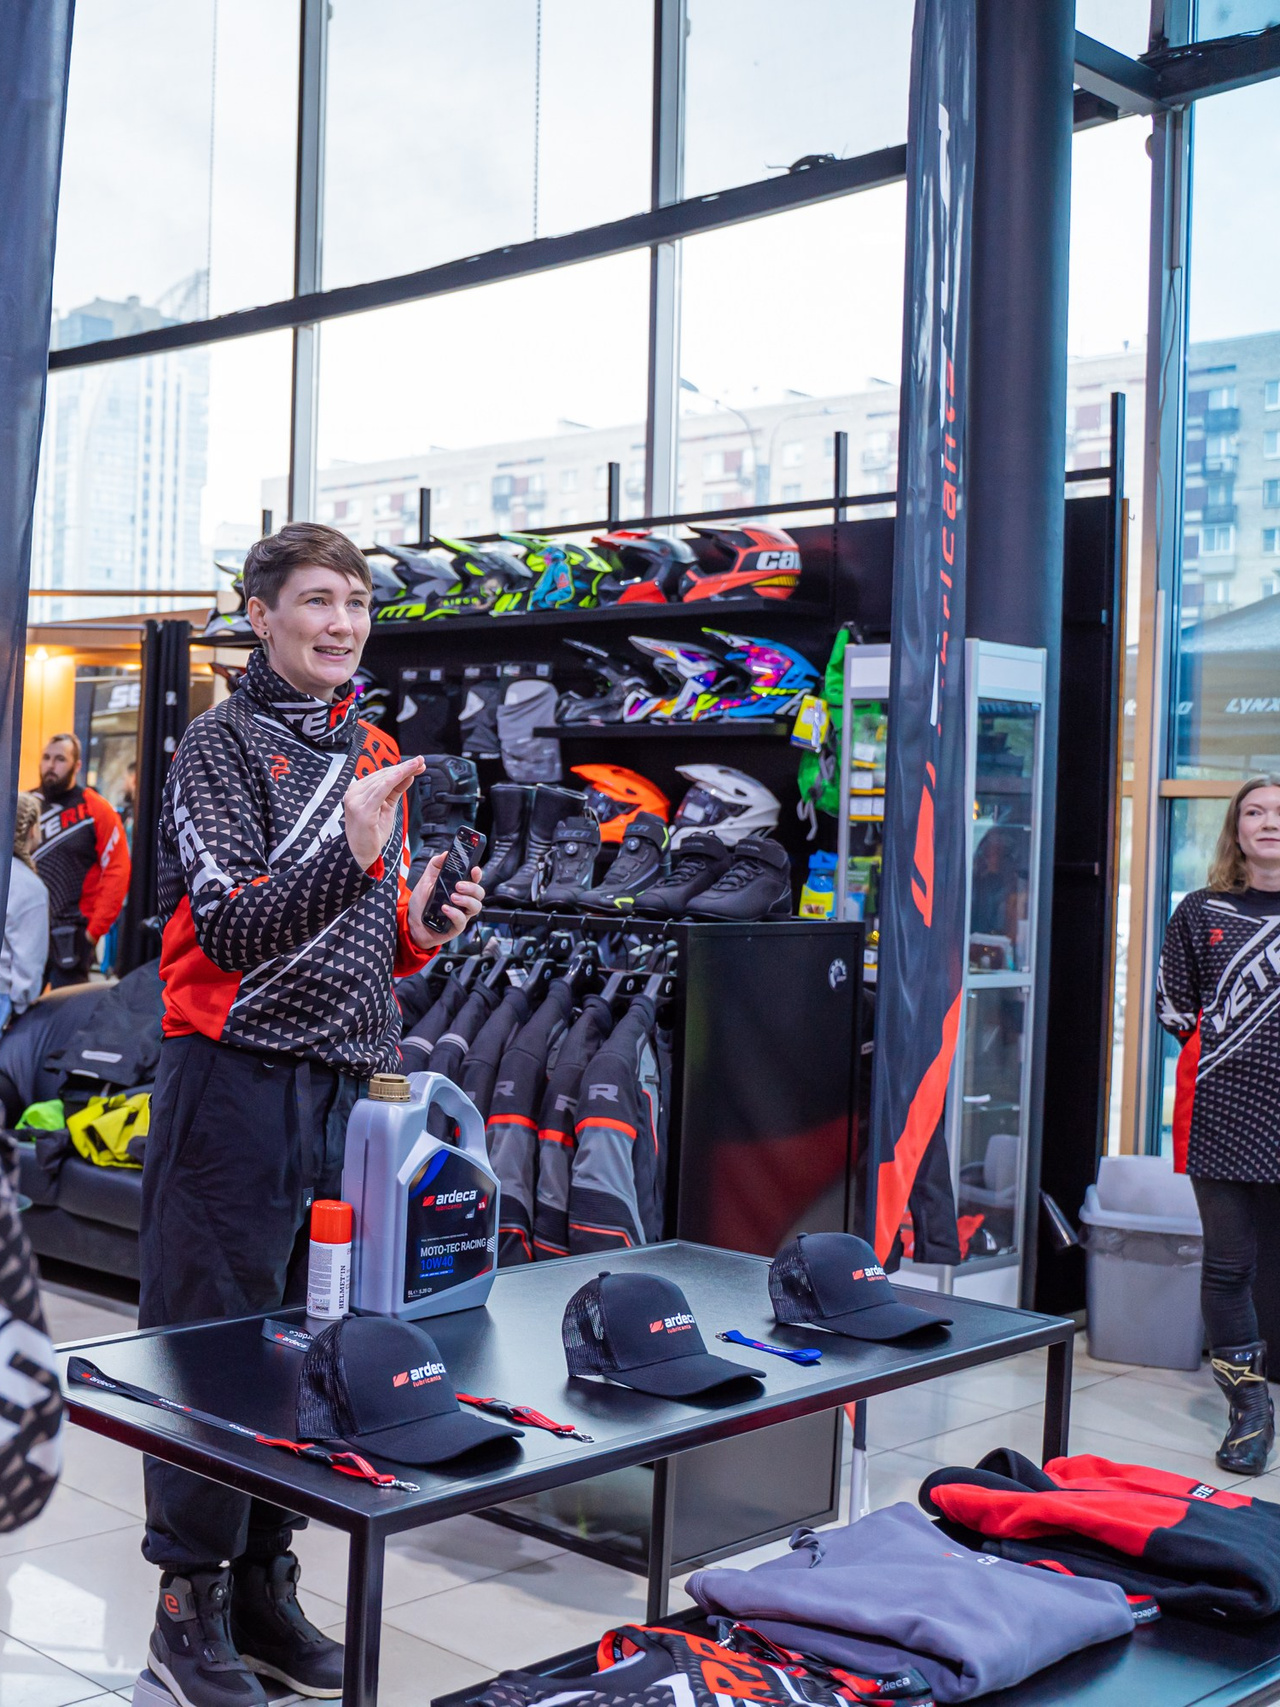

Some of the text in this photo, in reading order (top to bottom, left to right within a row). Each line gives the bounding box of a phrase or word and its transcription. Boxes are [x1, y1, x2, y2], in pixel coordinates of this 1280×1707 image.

[1225, 697, 1280, 714] LYNX
[435, 1189, 477, 1205] ardeca
[420, 1243, 460, 1258] MOTO-TEC
[460, 1237, 487, 1252] RACING
[420, 1255, 454, 1271] 10W40
